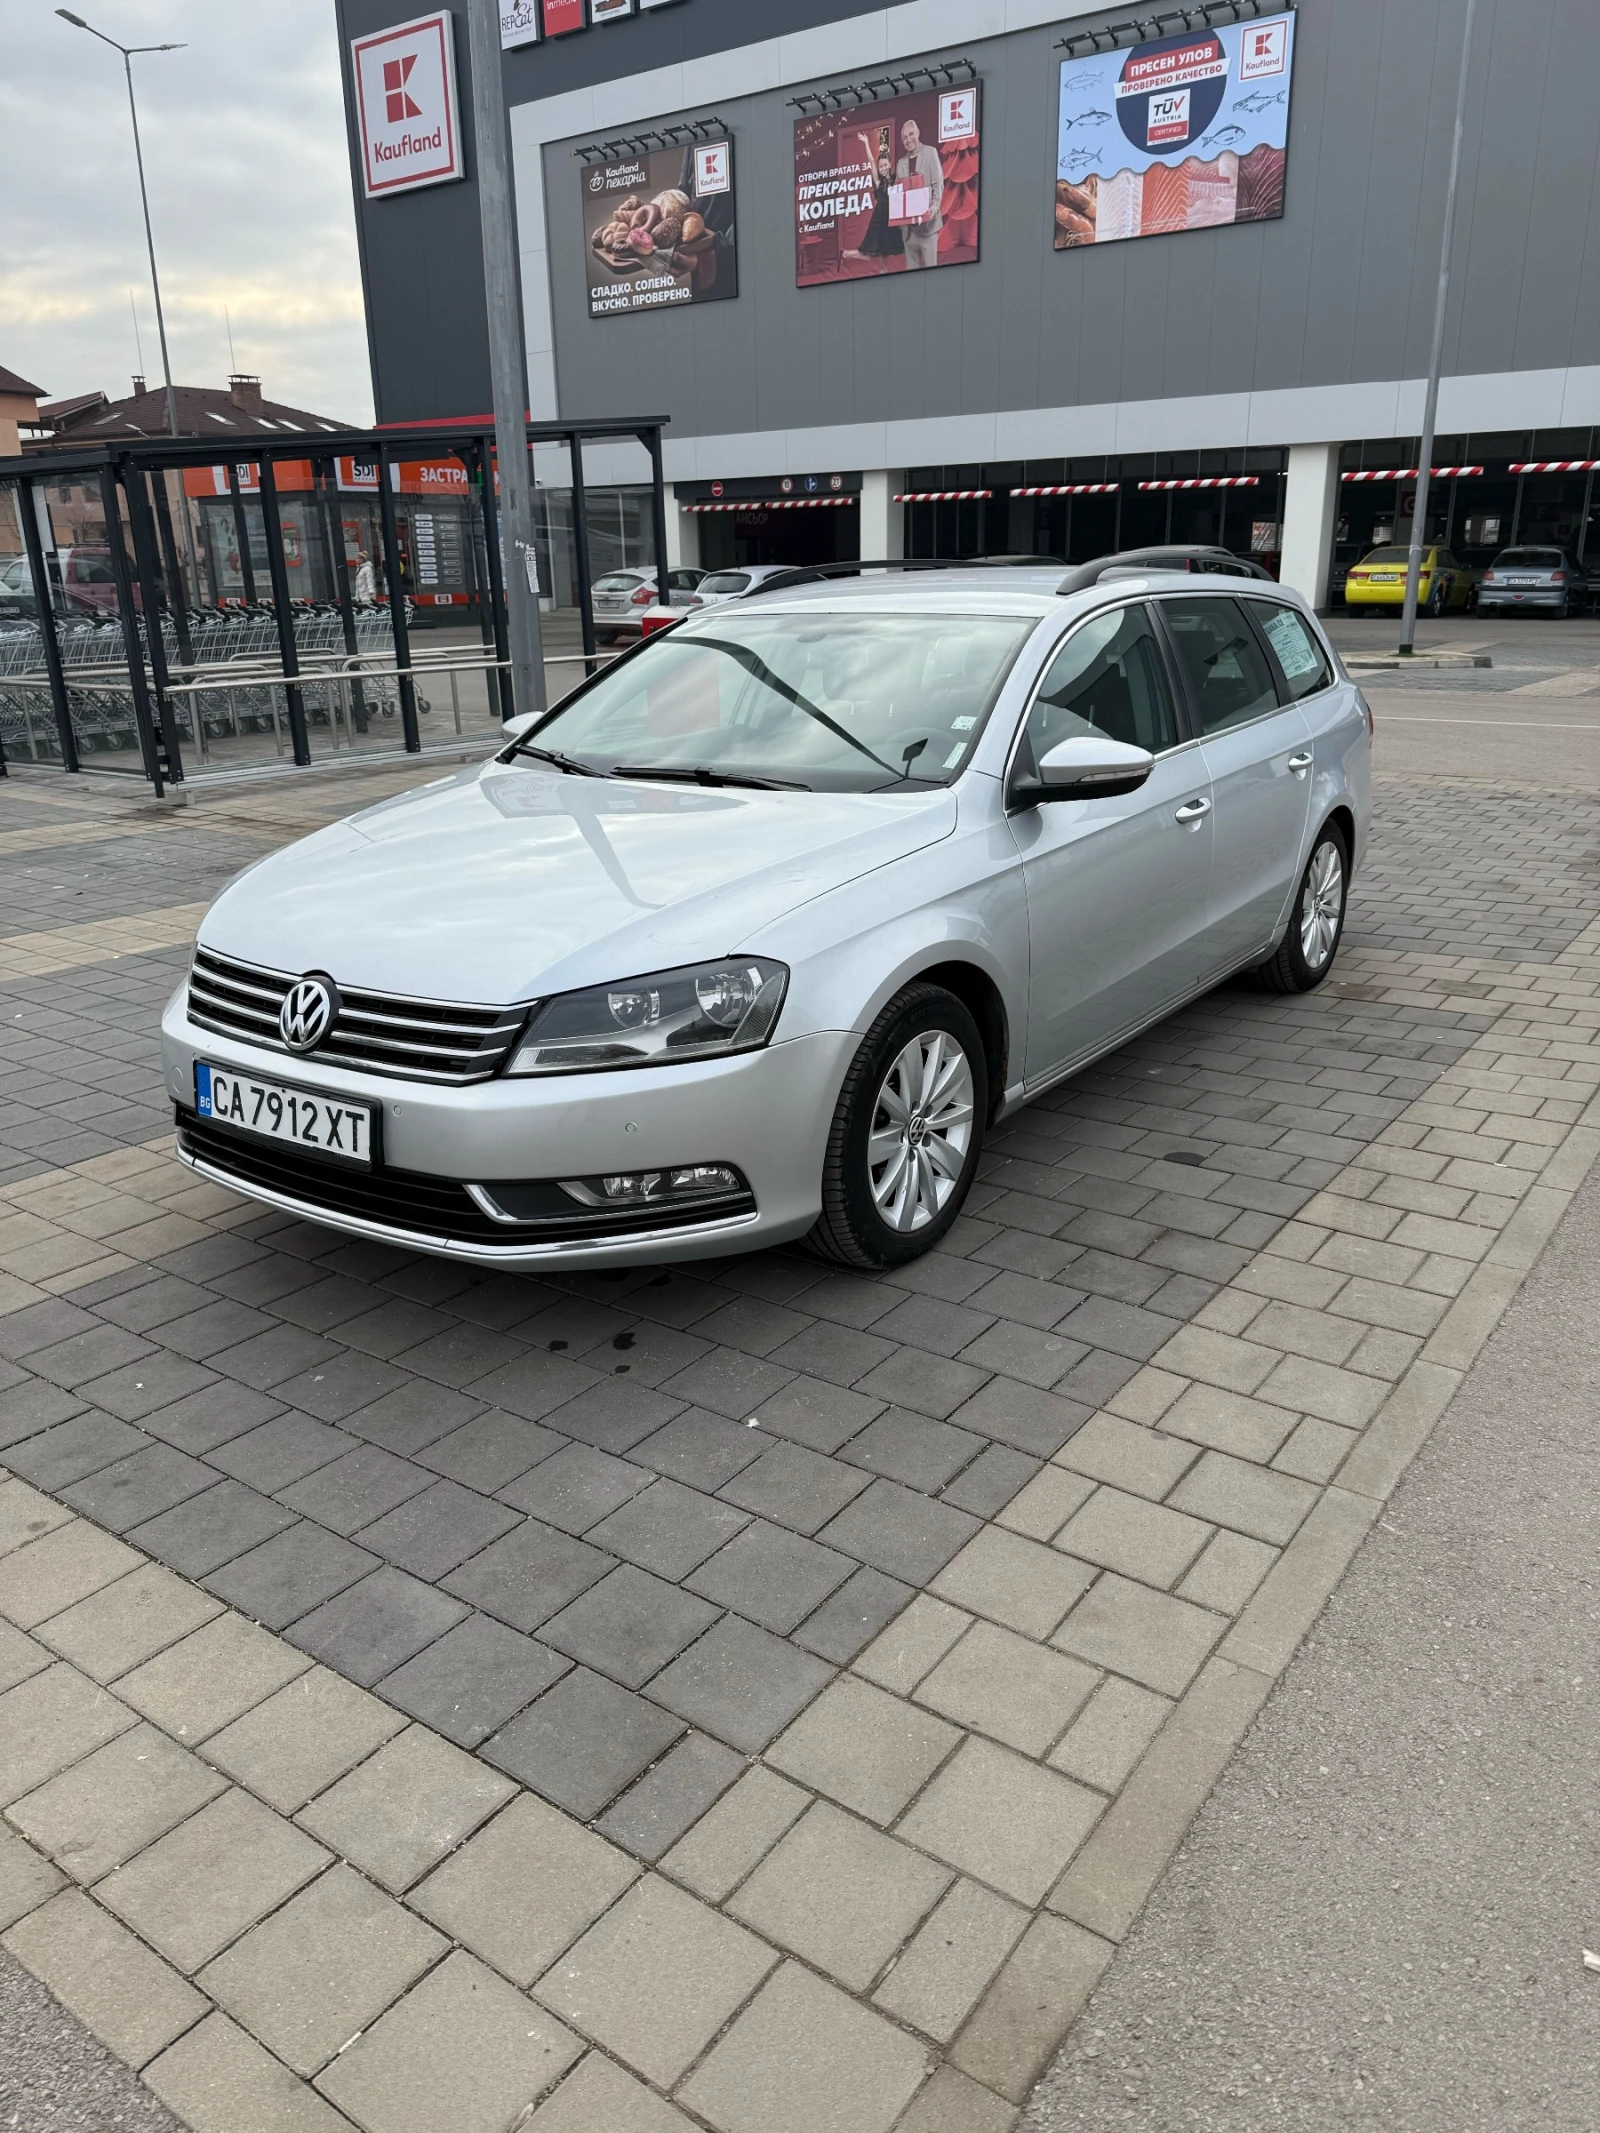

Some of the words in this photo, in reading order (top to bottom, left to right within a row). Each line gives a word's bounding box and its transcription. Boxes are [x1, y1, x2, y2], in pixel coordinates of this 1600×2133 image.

[1130, 55, 1176, 78] ПРЕСЕН
[1178, 46, 1213, 65] УЛОВ
[1245, 56, 1280, 71] Kaufland
[1121, 75, 1173, 94] ПРОВЕРЕНО
[1175, 64, 1223, 82] КАЧЕСТВО
[943, 121, 970, 133] Kaufland
[1153, 114, 1182, 124] AUSTRIA
[1154, 125, 1183, 136] CERTIFIED
[374, 126, 442, 164] Kaufland
[605, 162, 639, 179] Kaufland
[798, 169, 828, 183] ОТВОРИ
[829, 164, 861, 177] ВРАТАТА
[861, 161, 873, 171] ЗА
[606, 171, 647, 189] пекарна
[700, 176, 725, 187] Kaufland
[798, 174, 873, 201] ПРЕКРАСНА
[799, 192, 874, 222] КОЛЕДА
[804, 220, 835, 233] Kaufland
[591, 282, 634, 298] СЛАДКО.
[635, 275, 677, 292] СОЛЕНО.
[591, 296, 631, 312] ВКУСНО.
[632, 287, 692, 306] ПРОВЕРЕНО.
[354, 465, 376, 478] SDI
[200, 1095, 211, 1109] BG
